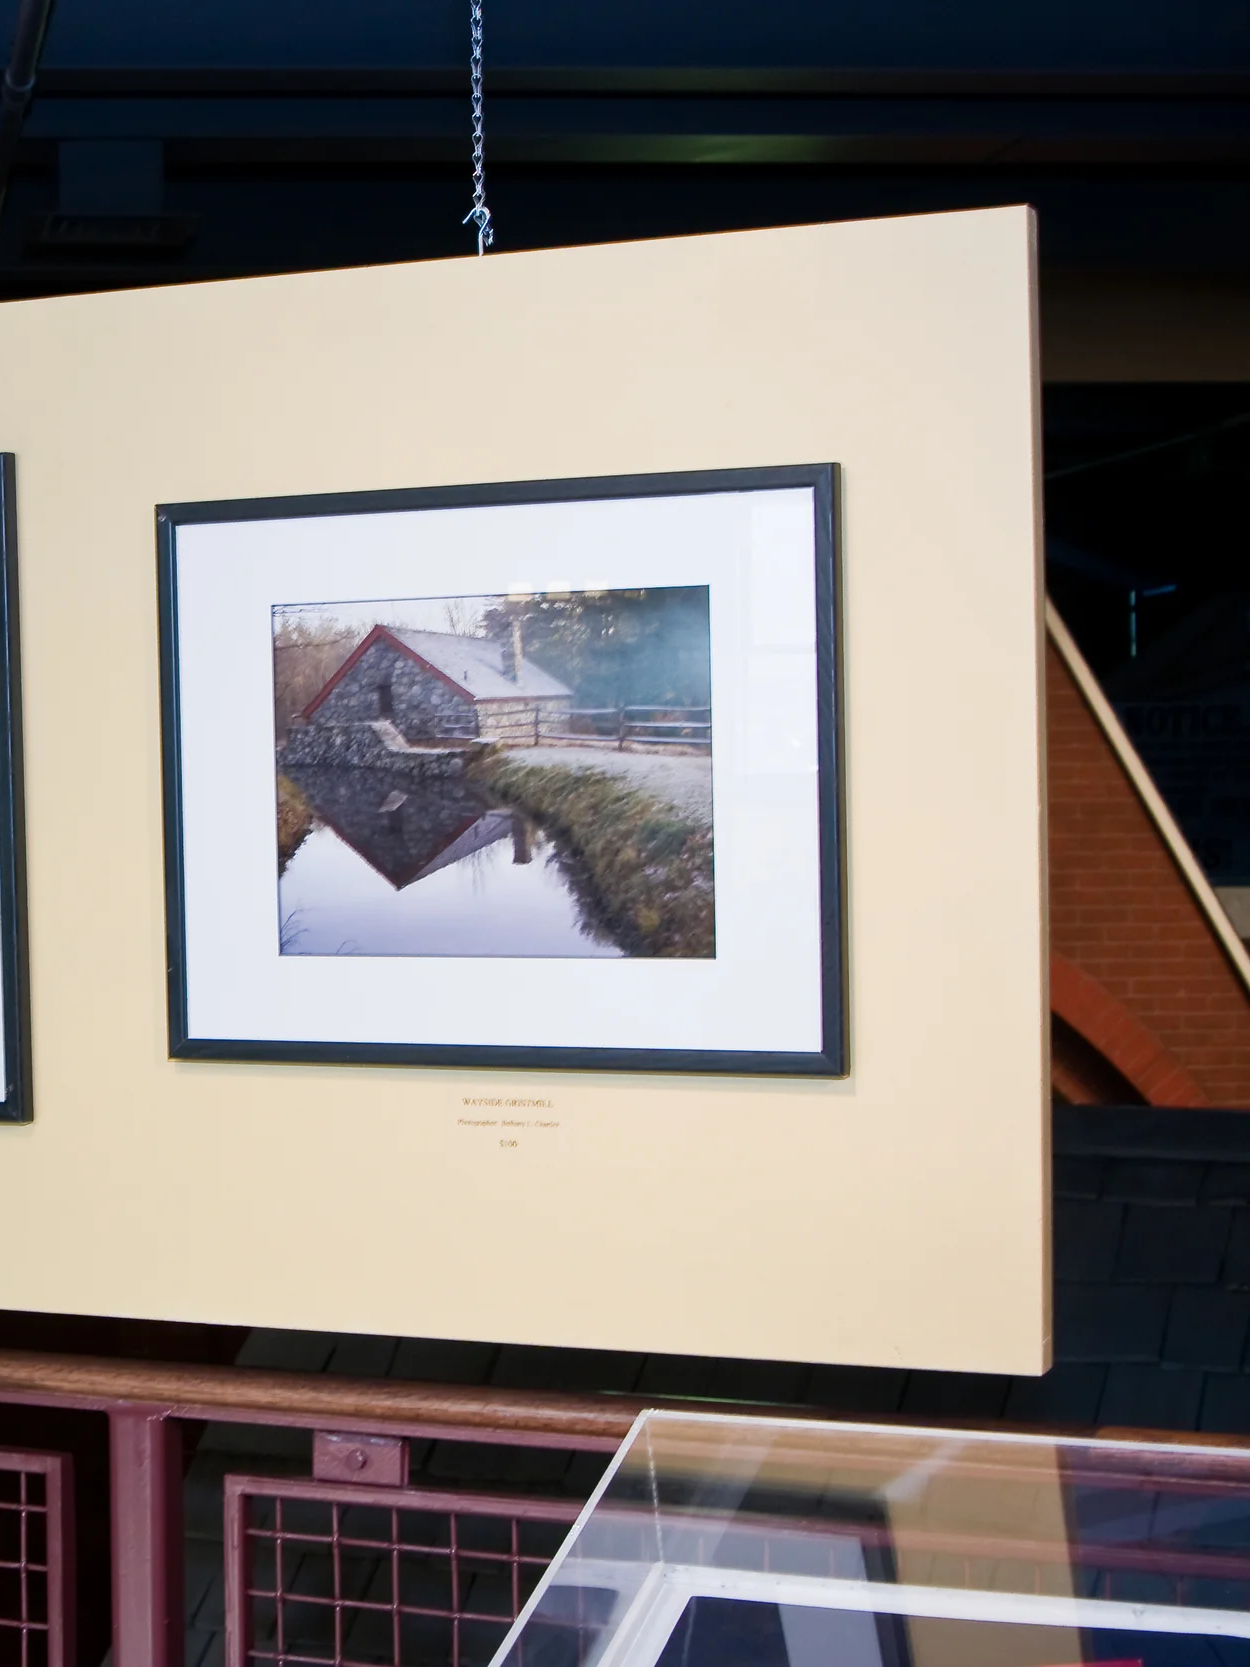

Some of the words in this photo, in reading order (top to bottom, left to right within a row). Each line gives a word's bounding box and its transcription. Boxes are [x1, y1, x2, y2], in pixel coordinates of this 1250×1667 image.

[1124, 704, 1241, 736] NOTICE
[461, 1098, 503, 1107] WAYSIDE
[505, 1099, 554, 1108] GRISTMILL
